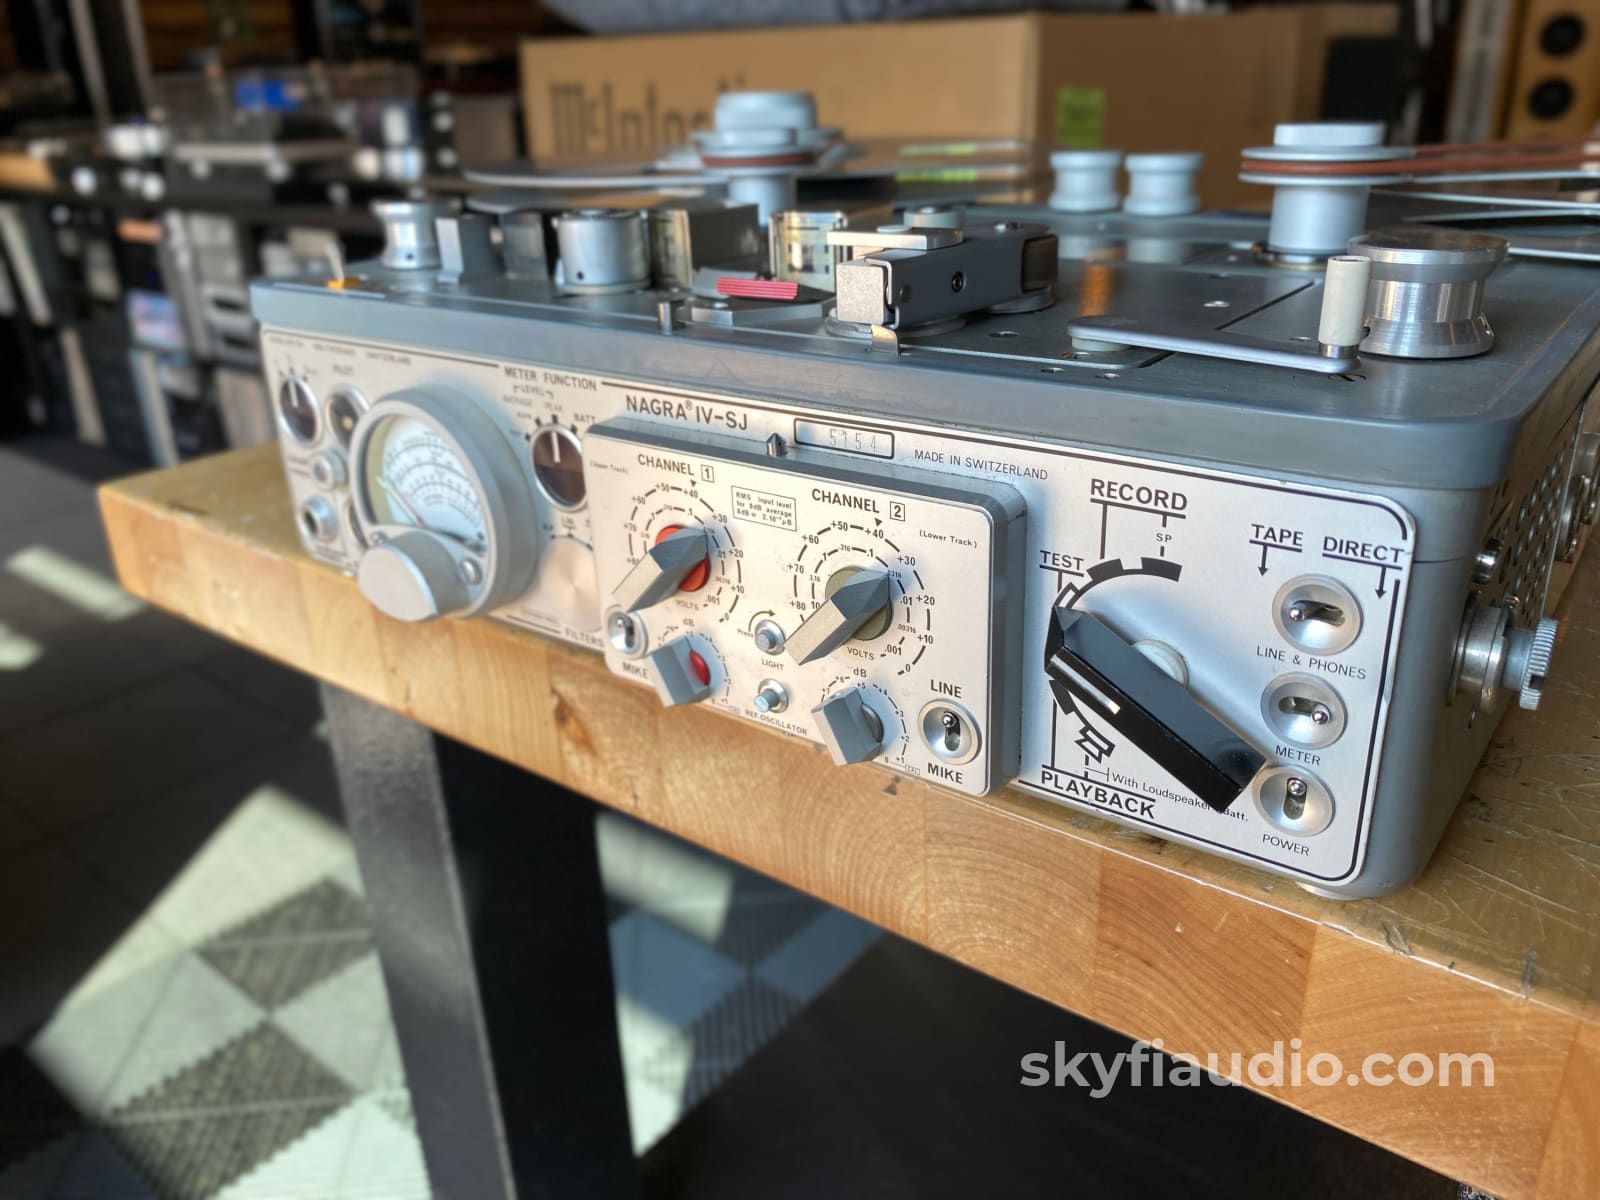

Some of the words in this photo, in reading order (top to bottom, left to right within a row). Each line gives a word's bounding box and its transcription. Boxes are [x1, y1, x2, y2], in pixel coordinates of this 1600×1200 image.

[504, 367, 537, 382] METER
[543, 371, 597, 391] FUNCTION
[696, 406, 748, 431] IV-SJ
[829, 428, 877, 452] 5154
[637, 453, 695, 476] CHANNEL
[914, 449, 945, 464] MADE
[950, 455, 961, 466] IN
[965, 457, 1048, 480] SWITZERLAND
[683, 489, 699, 500] +40
[811, 488, 880, 514] CHANNEL
[1090, 478, 1188, 511] RECORD
[711, 513, 728, 524] +30
[831, 520, 849, 532] +50
[802, 533, 820, 545] +60
[865, 528, 884, 540] +40
[1155, 532, 1173, 543] SP
[1251, 523, 1304, 547] TAPE
[1322, 536, 1405, 563] DIRECT
[728, 548, 744, 559] +20
[896, 555, 916, 567] +30
[1039, 550, 1085, 571] TEST
[787, 562, 805, 575] +70
[731, 583, 745, 594] +10
[676, 599, 699, 612] VOLTS
[789, 600, 806, 612] +80
[916, 594, 936, 606] +20
[917, 633, 934, 645] +10
[846, 646, 875, 661] VOLTS
[621, 661, 649, 678] MIKE
[761, 656, 785, 671] LIGHT
[1256, 645, 1286, 661] LINE
[1292, 655, 1302, 665] &
[1308, 657, 1367, 680] PHONES
[852, 666, 868, 678] dB
[930, 679, 962, 699] LINE
[1275, 745, 1321, 766] METER
[927, 762, 963, 785] MIKE
[1111, 772, 1138, 789] With
[1041, 770, 1155, 819] PLAYBACK
[1262, 833, 1310, 857] POWER
